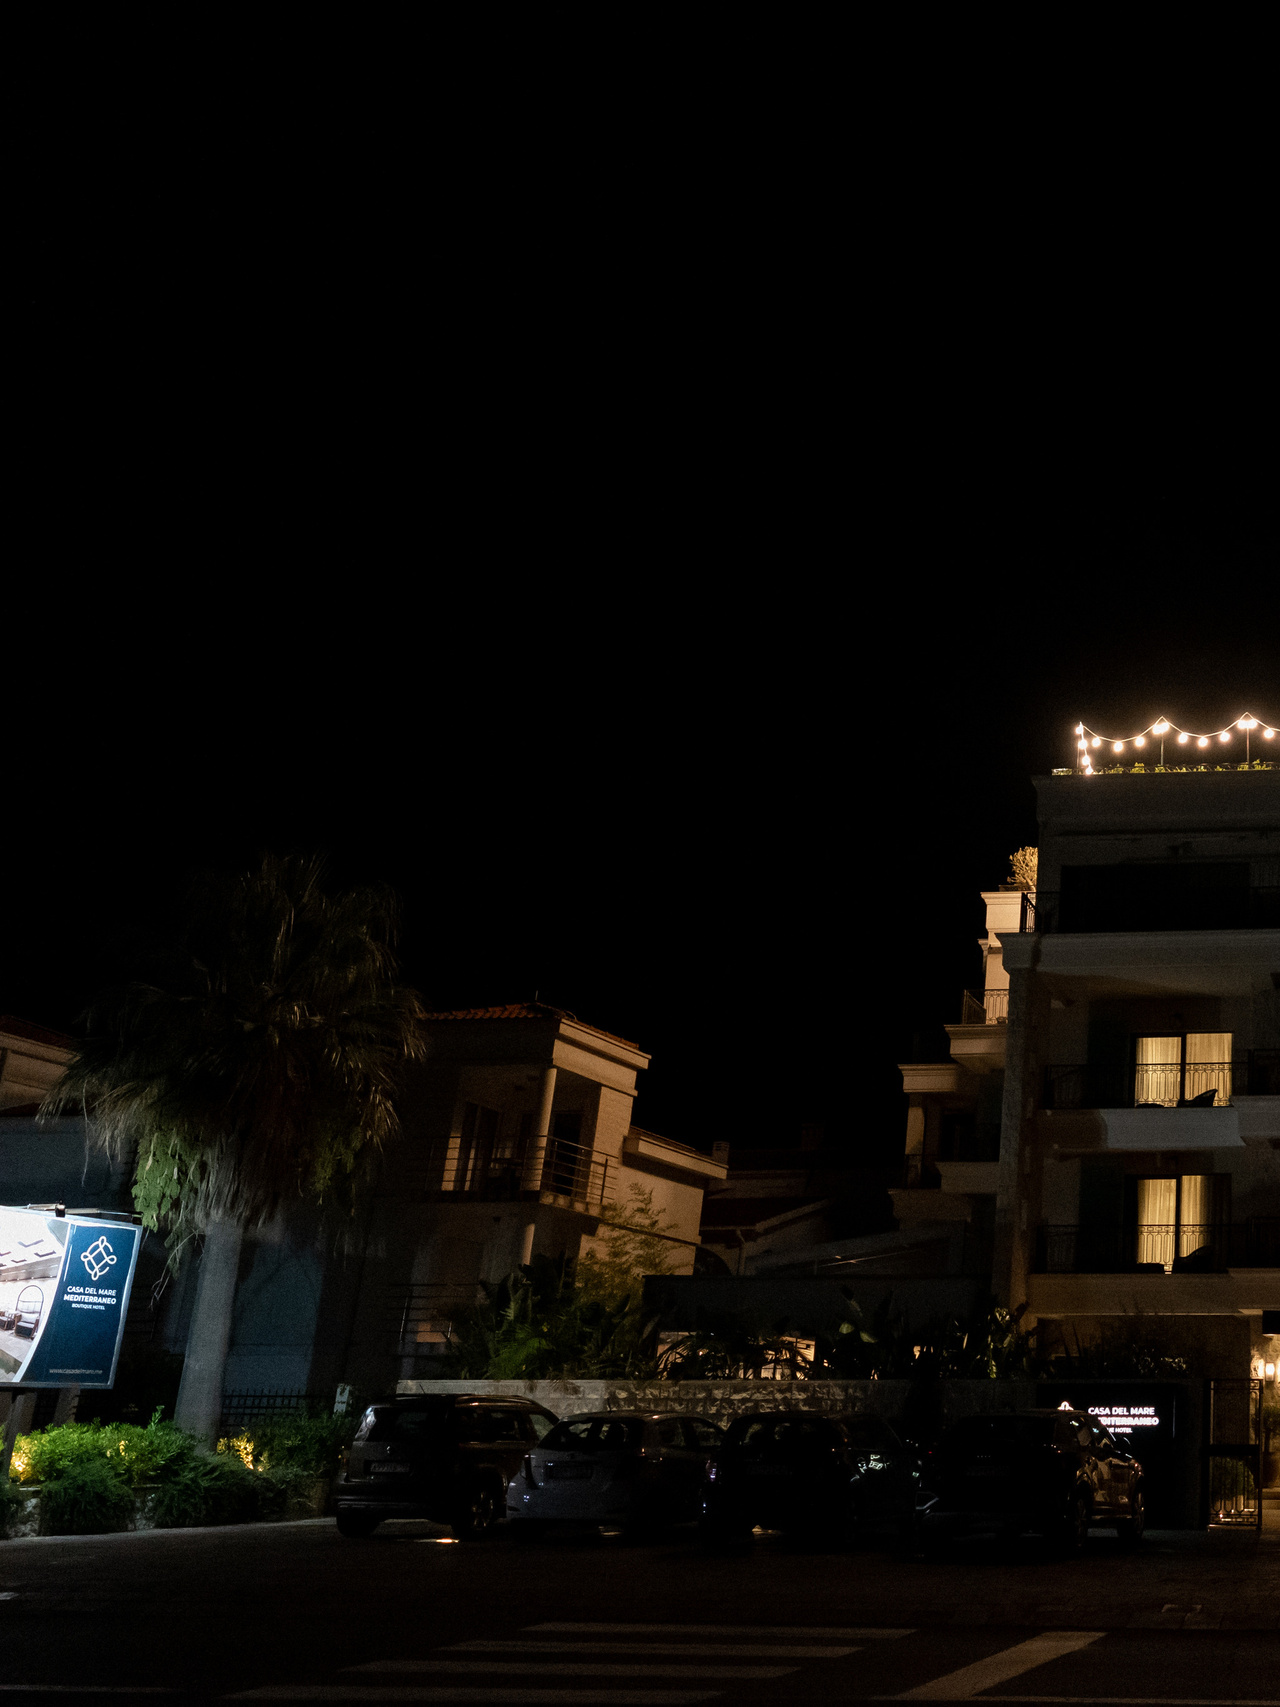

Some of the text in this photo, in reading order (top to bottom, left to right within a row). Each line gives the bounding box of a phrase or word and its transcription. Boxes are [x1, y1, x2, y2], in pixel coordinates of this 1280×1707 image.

[98, 1288, 117, 1296] MARE
[63, 1294, 116, 1304] MEDITERRANEO
[1088, 1407, 1155, 1415] CASA DEL MARE
[1098, 1416, 1159, 1425] DITERRANEO
